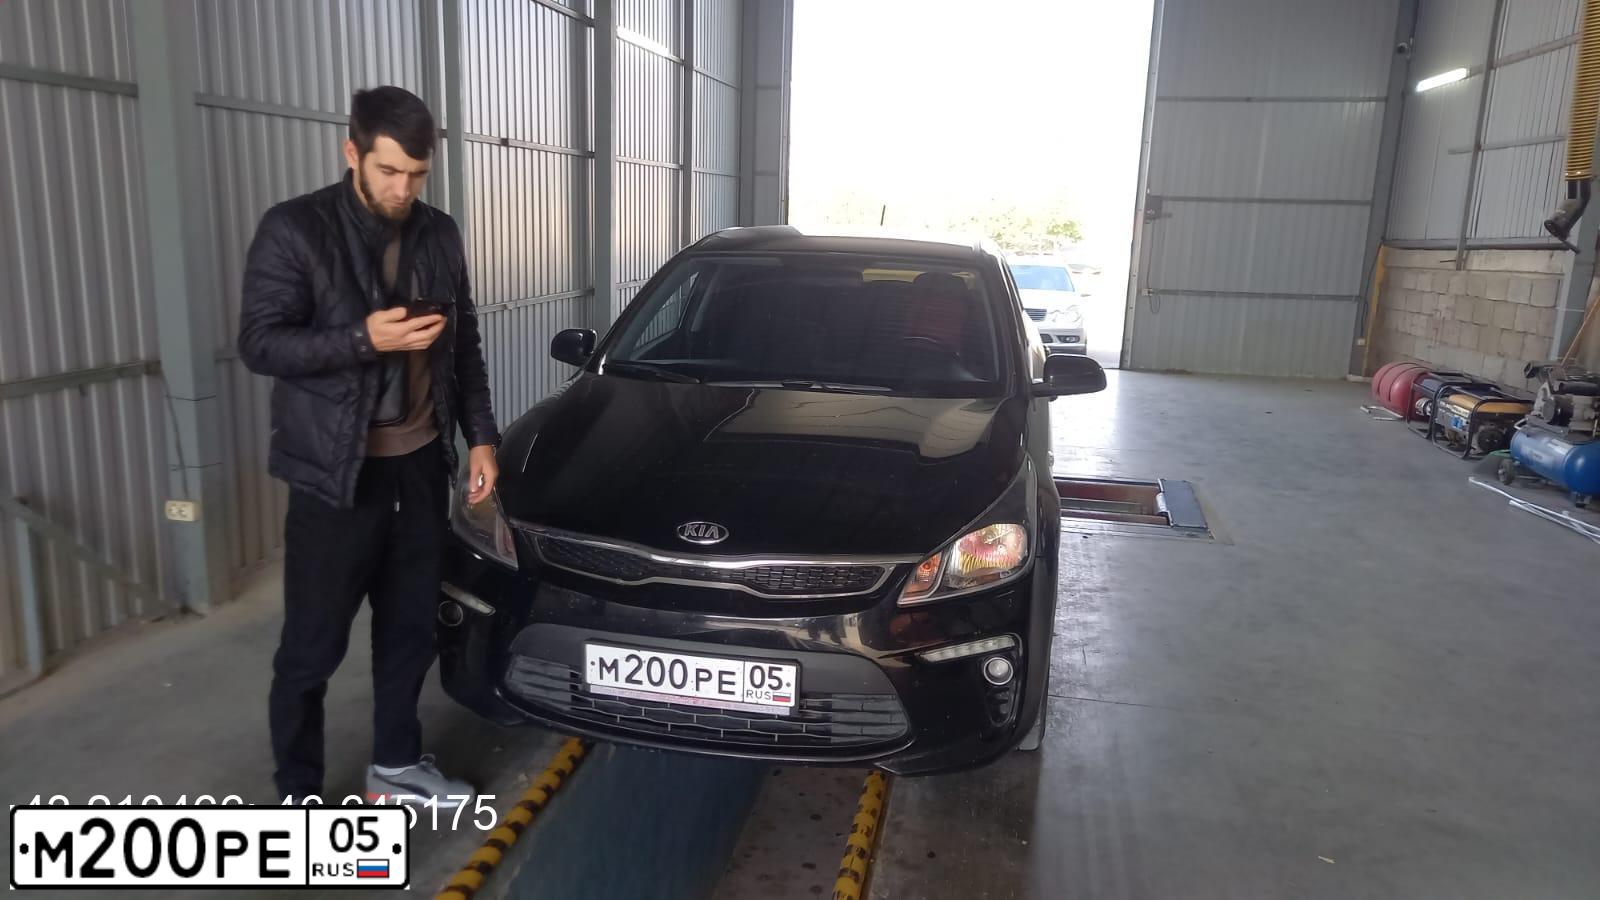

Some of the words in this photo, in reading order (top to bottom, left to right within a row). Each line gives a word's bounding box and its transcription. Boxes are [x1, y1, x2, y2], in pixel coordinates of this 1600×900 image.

[684, 524, 719, 539] KIA
[749, 665, 783, 690] 05
[746, 689, 772, 701] RUS
